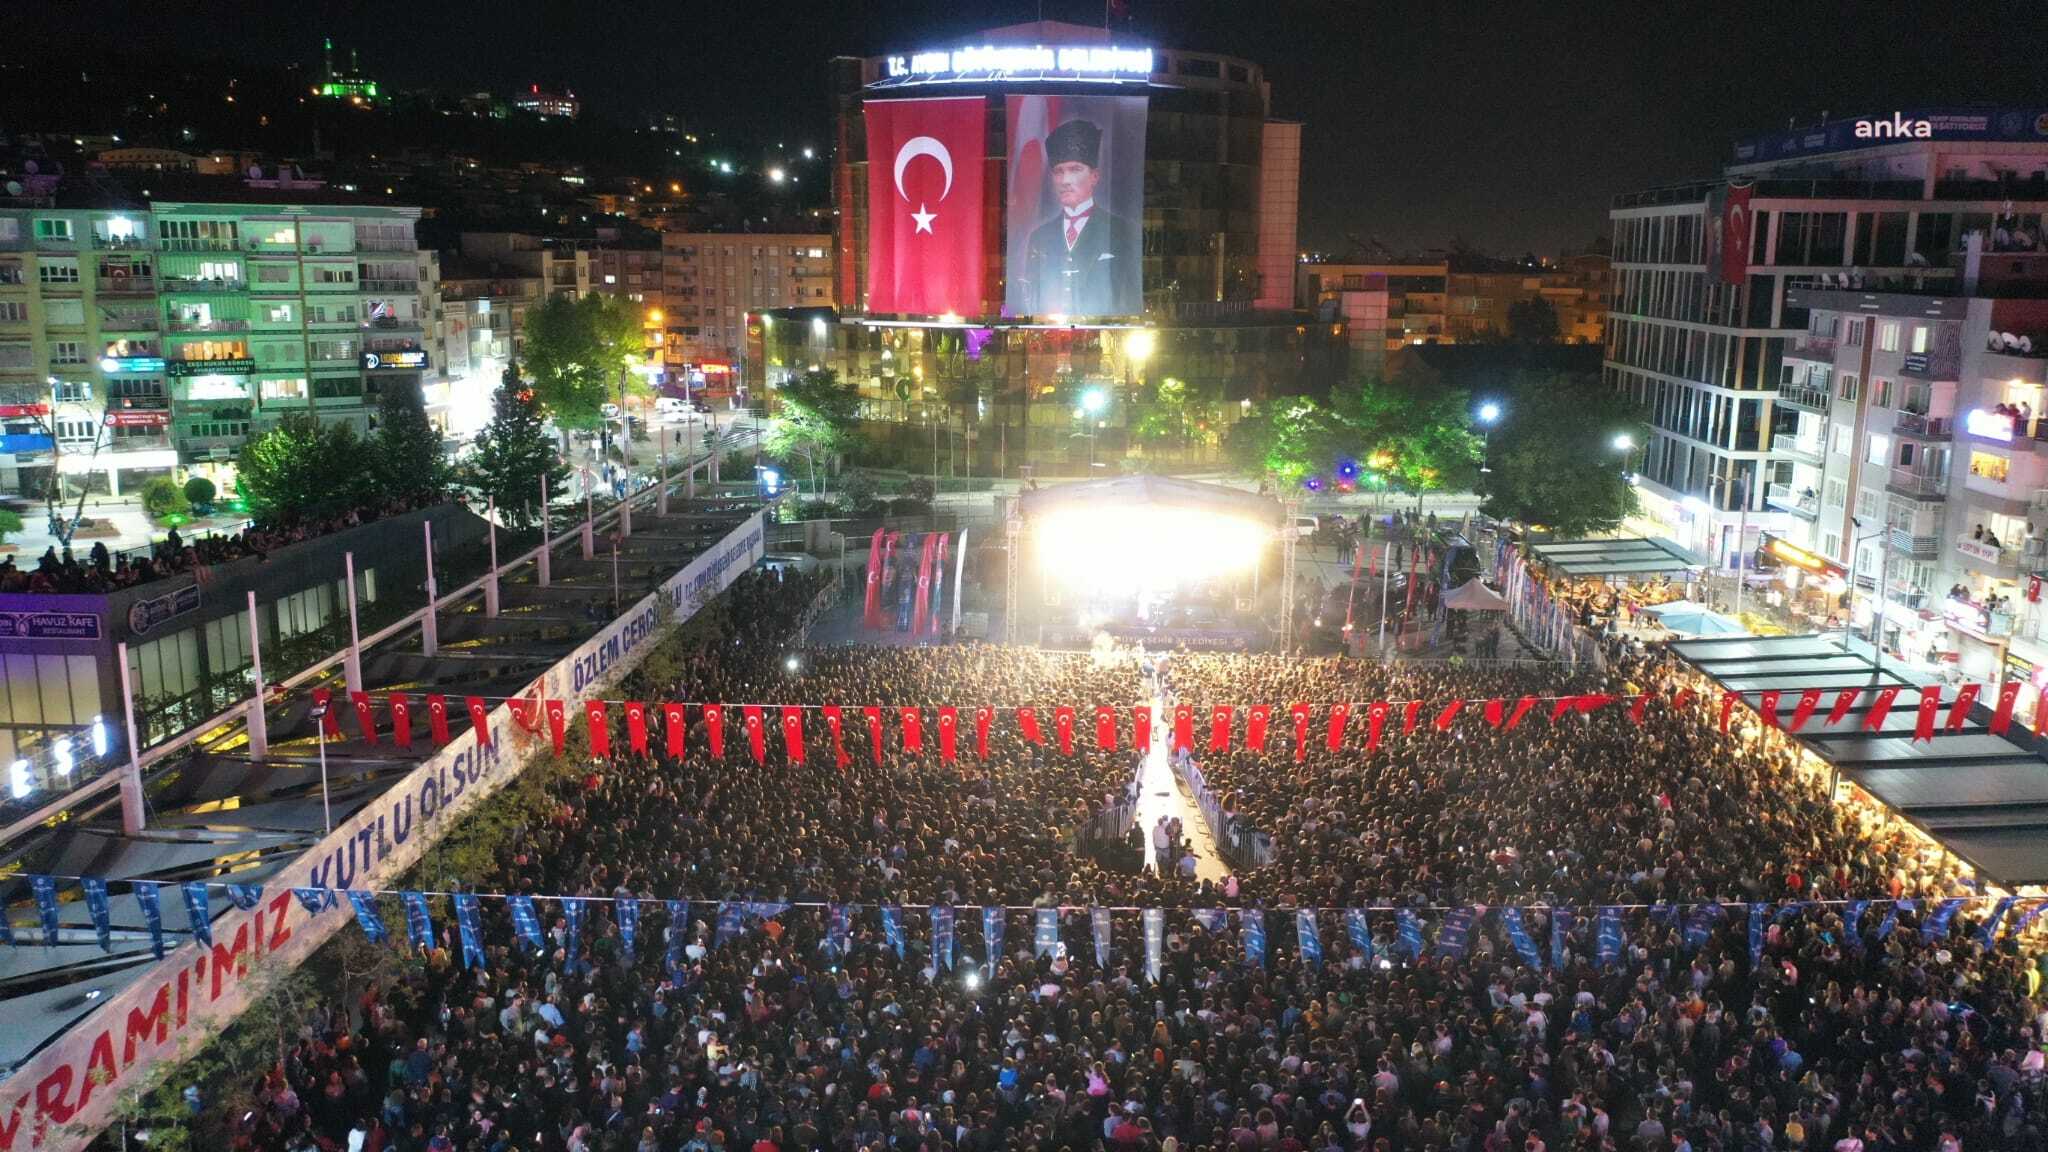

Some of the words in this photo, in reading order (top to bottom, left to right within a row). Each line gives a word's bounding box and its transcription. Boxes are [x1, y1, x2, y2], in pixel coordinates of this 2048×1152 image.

[32, 616, 67, 627] HAVUZ
[68, 616, 94, 628] KAFE
[574, 635, 619, 692] ÖZLEM
[311, 793, 413, 890] KUTLU
[419, 726, 500, 819] OLSUN
